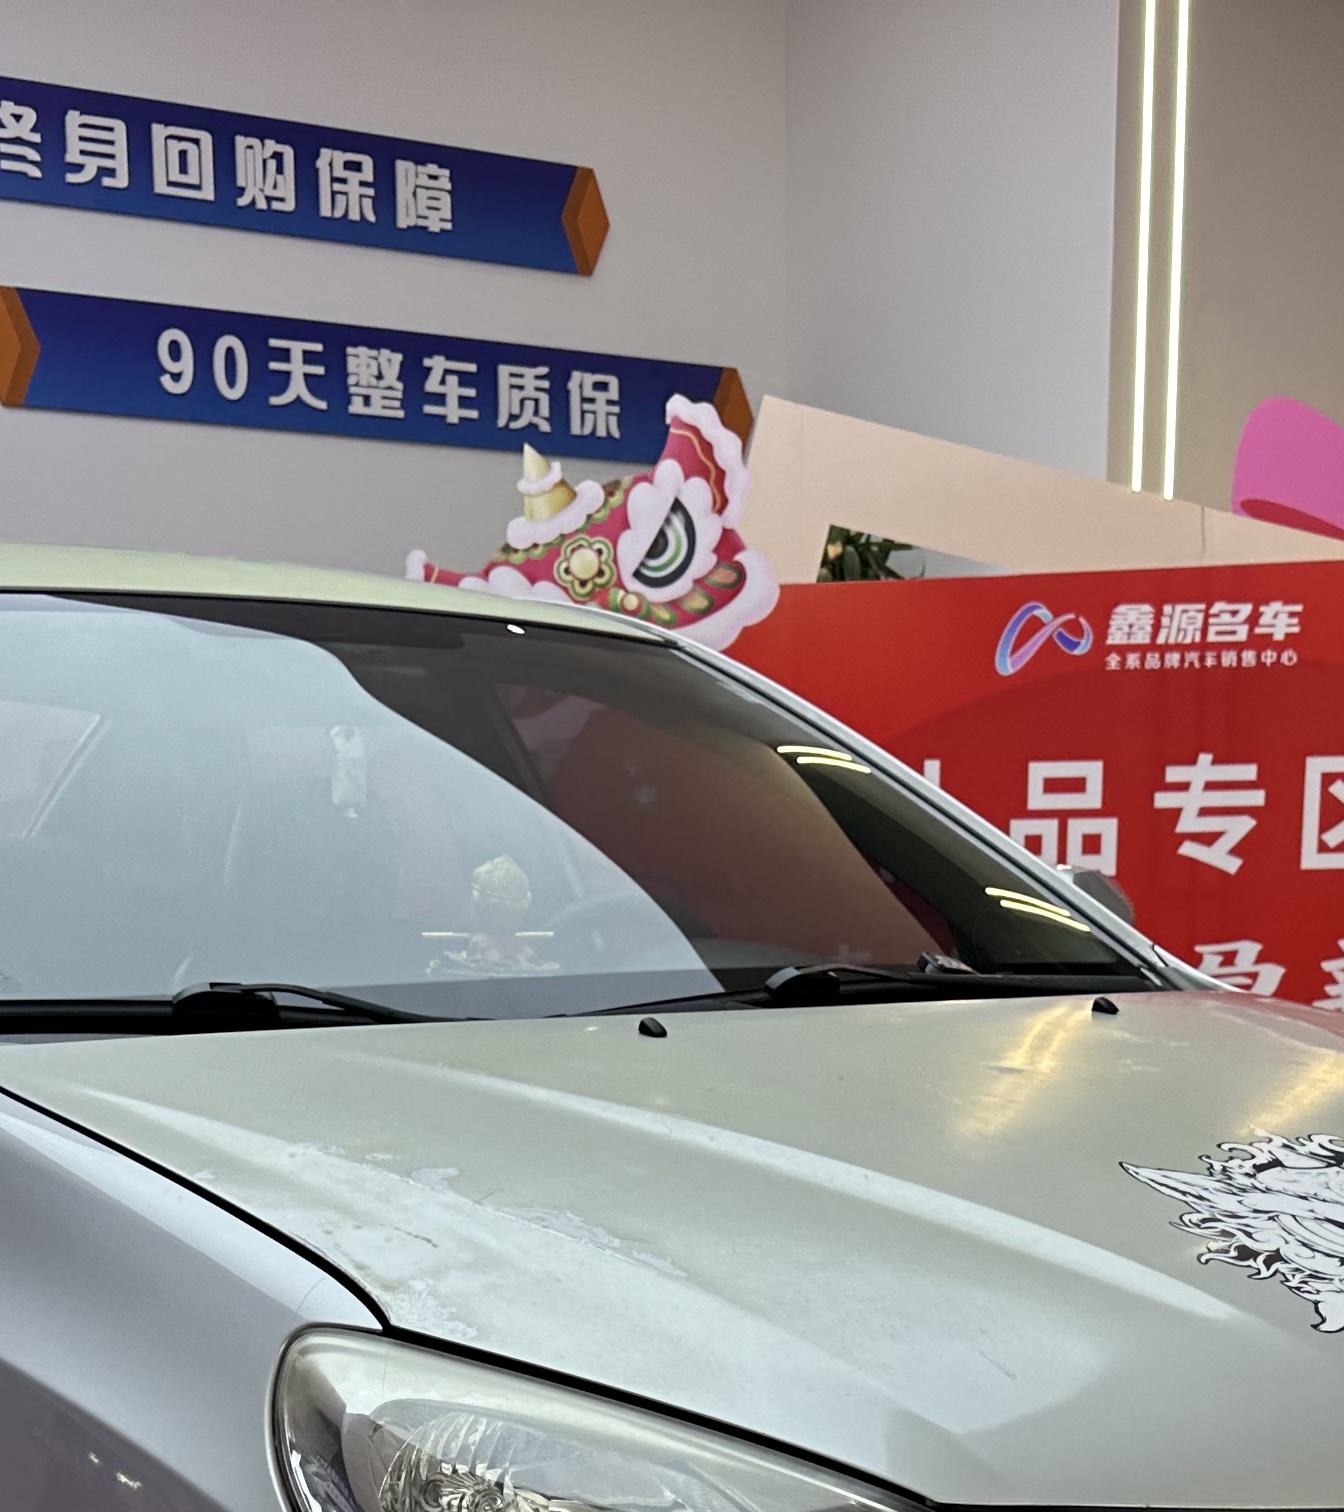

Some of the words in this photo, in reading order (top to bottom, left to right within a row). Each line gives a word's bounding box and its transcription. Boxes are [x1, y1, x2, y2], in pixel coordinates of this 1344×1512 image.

[156, 327, 622, 441] 90天整车质保
[1105, 601, 1303, 645] 鑫源名车
[1105, 648, 1298, 670] 全系品牌汽车销售中心
